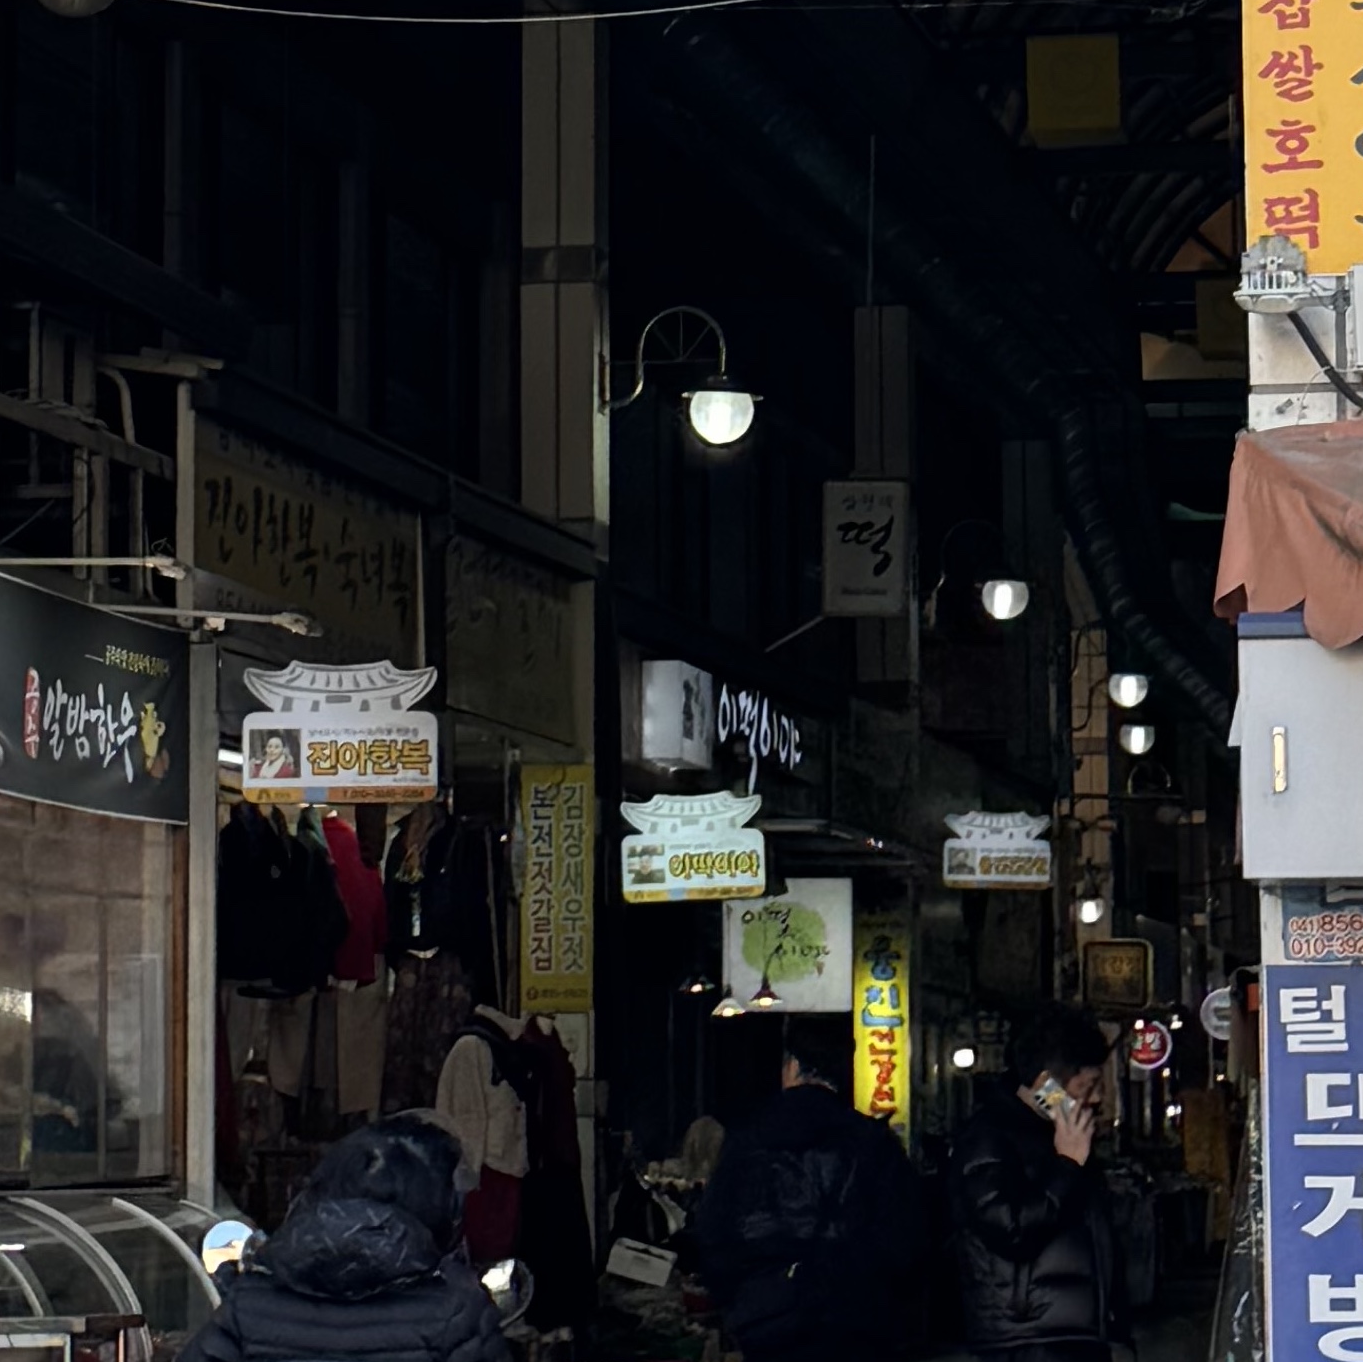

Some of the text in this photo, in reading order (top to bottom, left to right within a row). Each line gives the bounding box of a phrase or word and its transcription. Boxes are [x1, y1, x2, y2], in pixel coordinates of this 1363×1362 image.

[43, 678, 138, 784] 알밤한우
[307, 738, 433, 776] 진아한복
[561, 784, 585, 972] 김장새우젓
